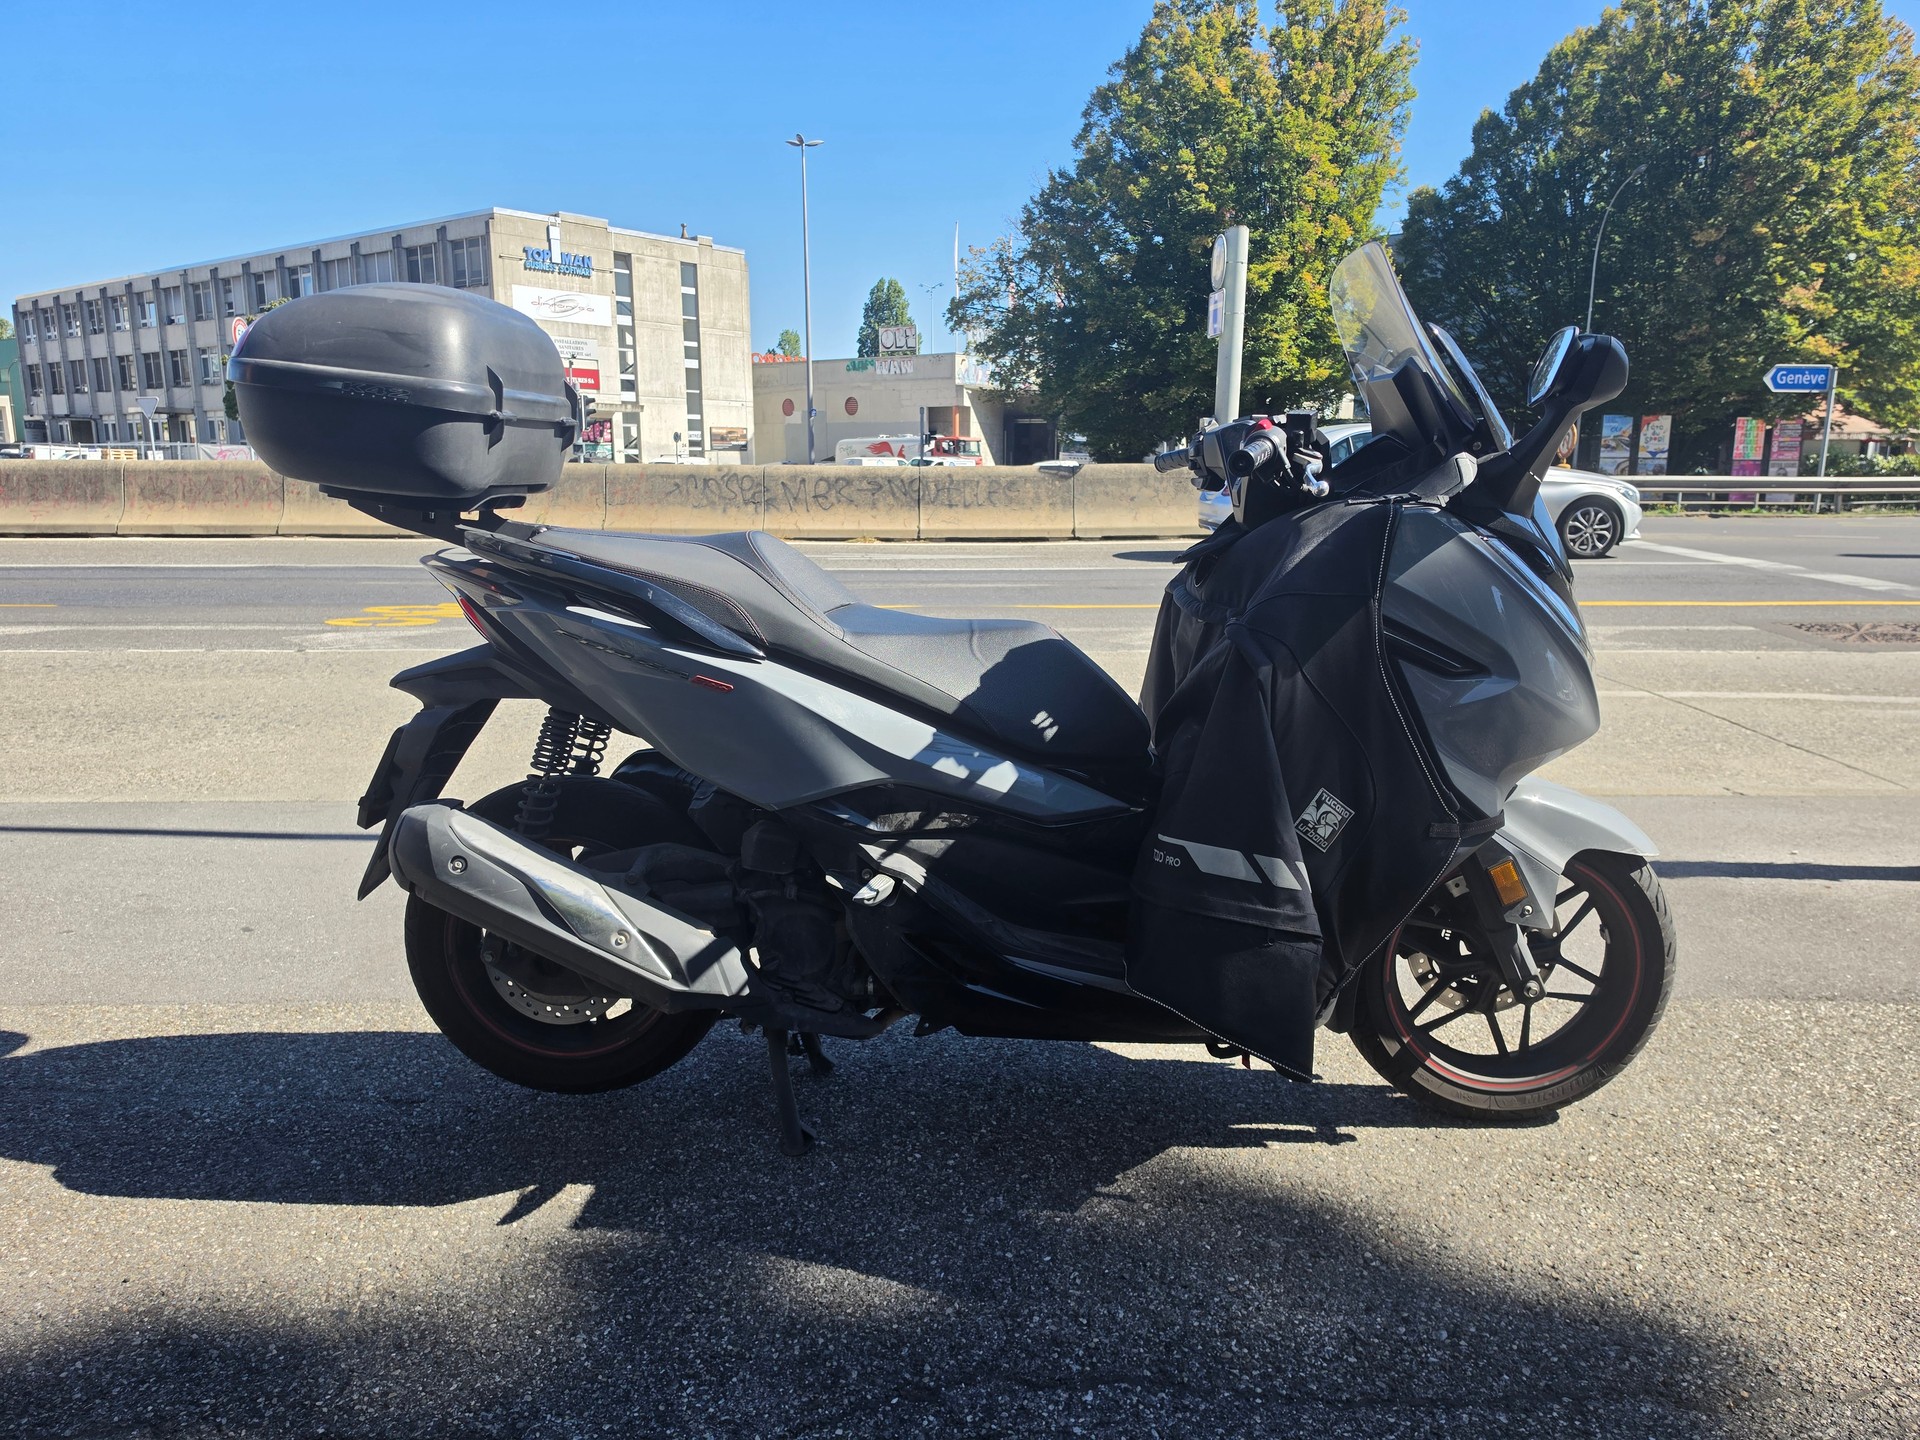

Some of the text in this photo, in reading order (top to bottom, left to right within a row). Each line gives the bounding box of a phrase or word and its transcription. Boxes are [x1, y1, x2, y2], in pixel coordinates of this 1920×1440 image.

[560, 252, 592, 268] MAN
[1776, 370, 1826, 385] Genève
[1165, 855, 1181, 867] PRO
